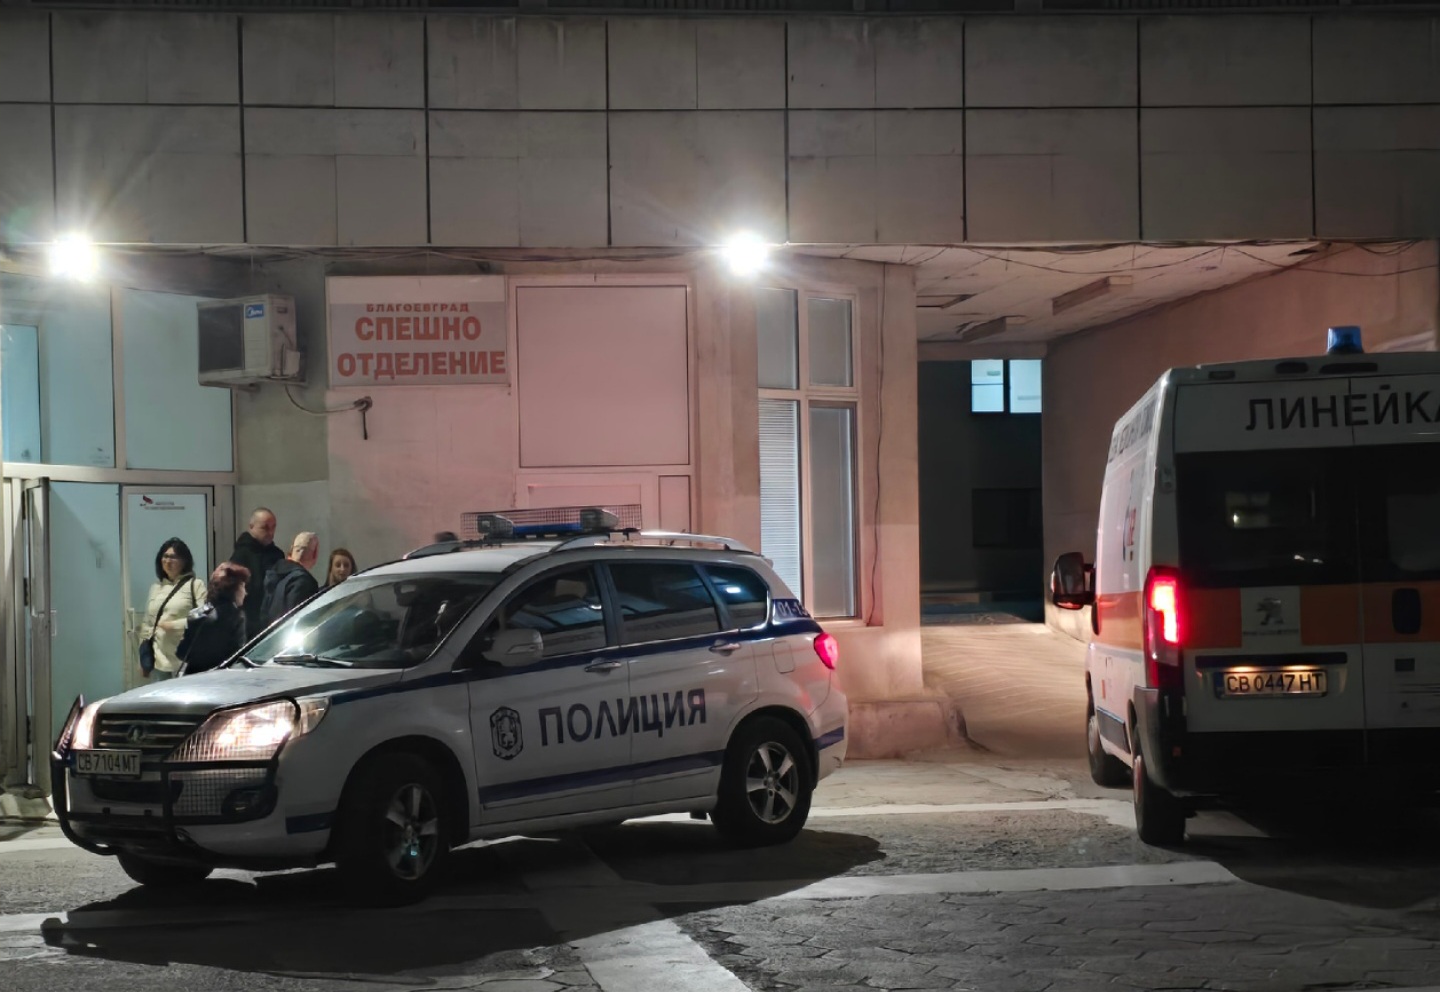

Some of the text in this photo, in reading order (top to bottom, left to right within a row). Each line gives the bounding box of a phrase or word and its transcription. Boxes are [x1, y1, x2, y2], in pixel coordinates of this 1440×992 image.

[366, 302, 470, 313] БЛАГОЕВГРАД
[354, 315, 482, 341] СПЕШНО
[337, 351, 506, 380] ОТДЕЛЕНИЕ
[1245, 384, 1440, 431] ЛИНЕЙК
[538, 688, 707, 747] ПОЛИЦИЯ
